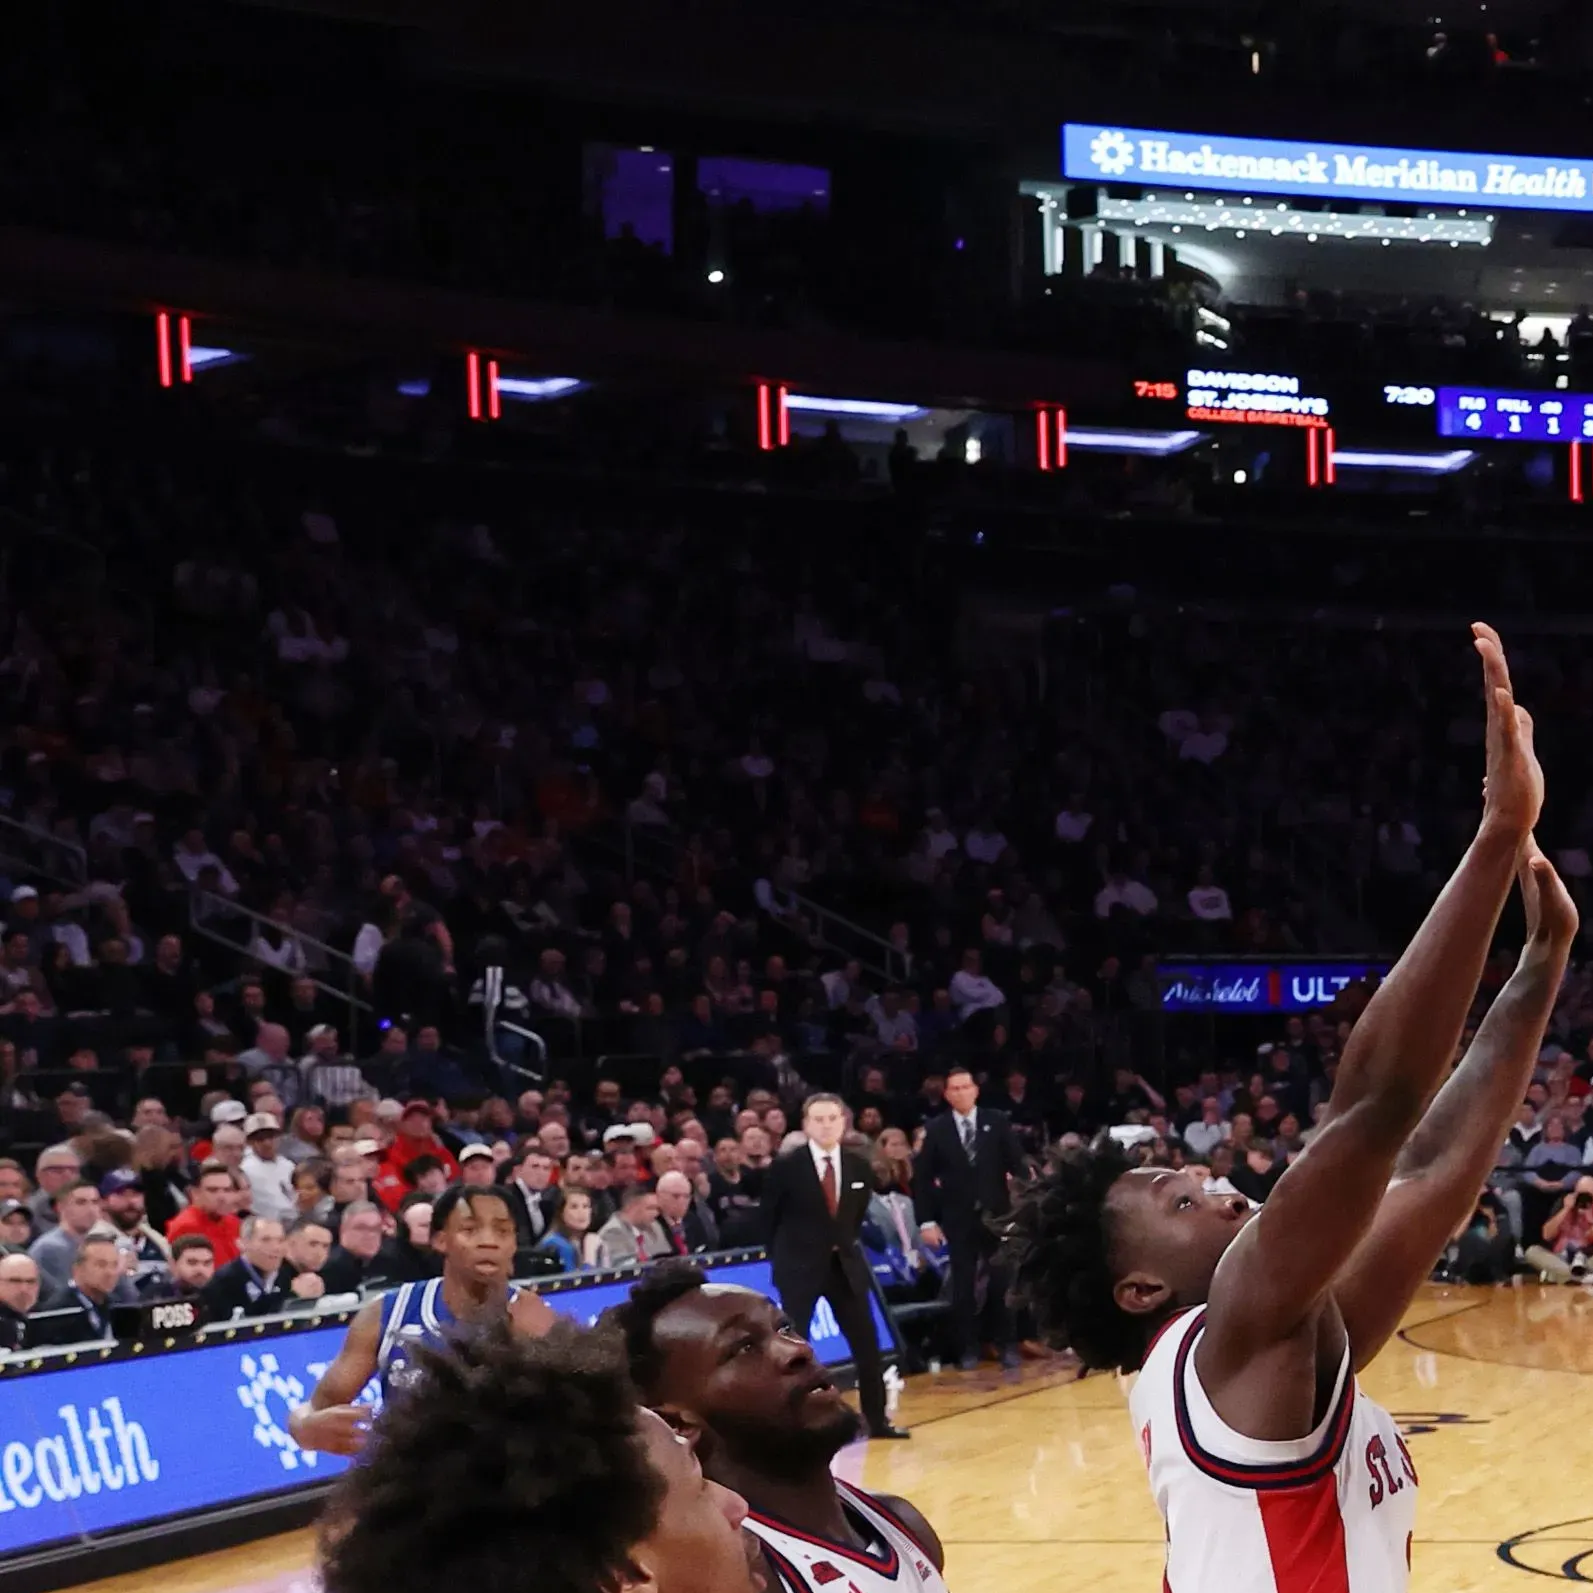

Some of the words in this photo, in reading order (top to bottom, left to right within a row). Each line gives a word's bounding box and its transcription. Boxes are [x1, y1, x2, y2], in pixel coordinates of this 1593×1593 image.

[1139, 140, 1328, 184] Hackensack
[1334, 154, 1477, 193] Meridian
[1482, 163, 1586, 198] Health
[1187, 369, 1299, 394] DAVIDSON
[1508, 415, 1522, 433] 1
[1547, 417, 1560, 435] 1
[151, 1302, 195, 1329] POSS
[0, 1396, 160, 1515] ealth
